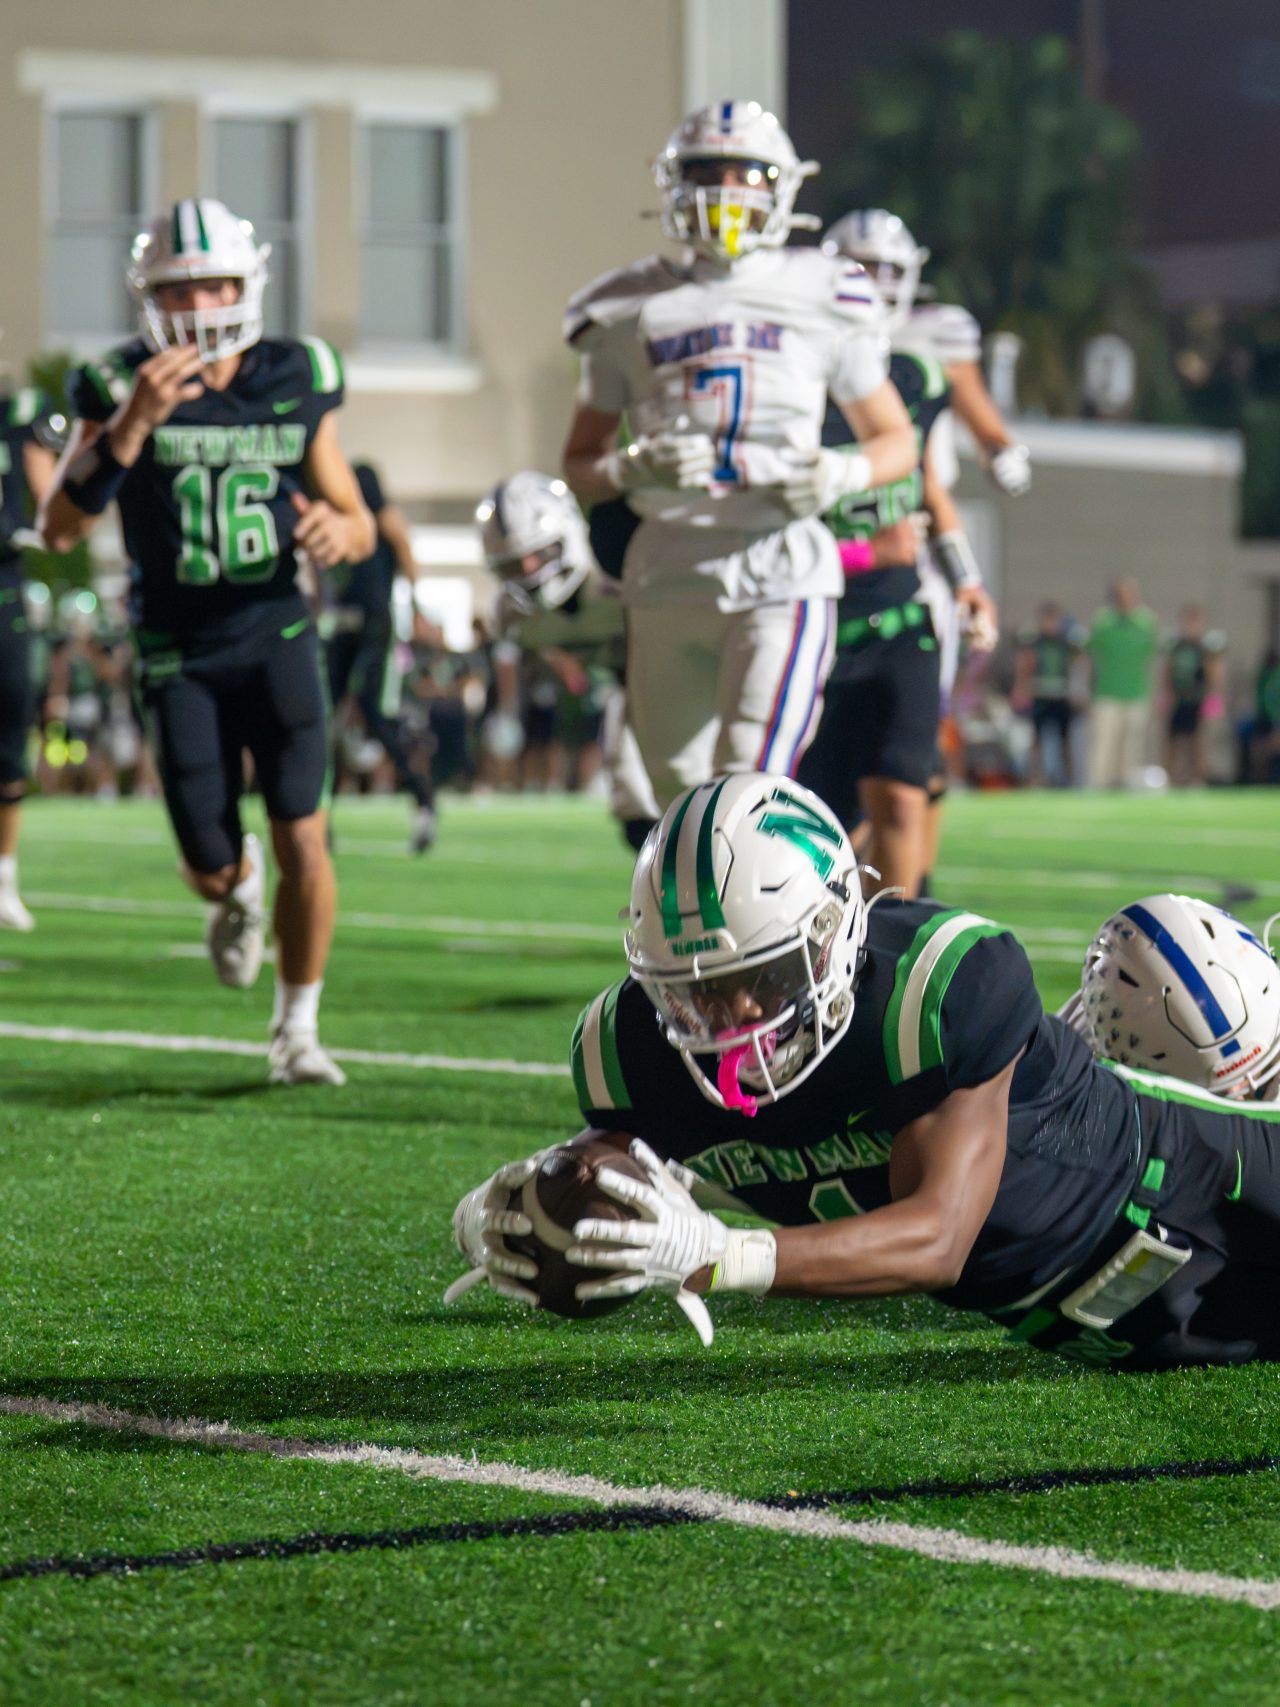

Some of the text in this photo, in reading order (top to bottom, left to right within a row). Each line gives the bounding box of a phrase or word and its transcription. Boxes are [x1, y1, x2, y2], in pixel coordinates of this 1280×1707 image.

[153, 424, 307, 466] NEWMAN
[684, 354, 753, 492] 7
[172, 464, 280, 585] 16
[756, 788, 843, 882] N
[682, 1130, 894, 1190] NEWMA
